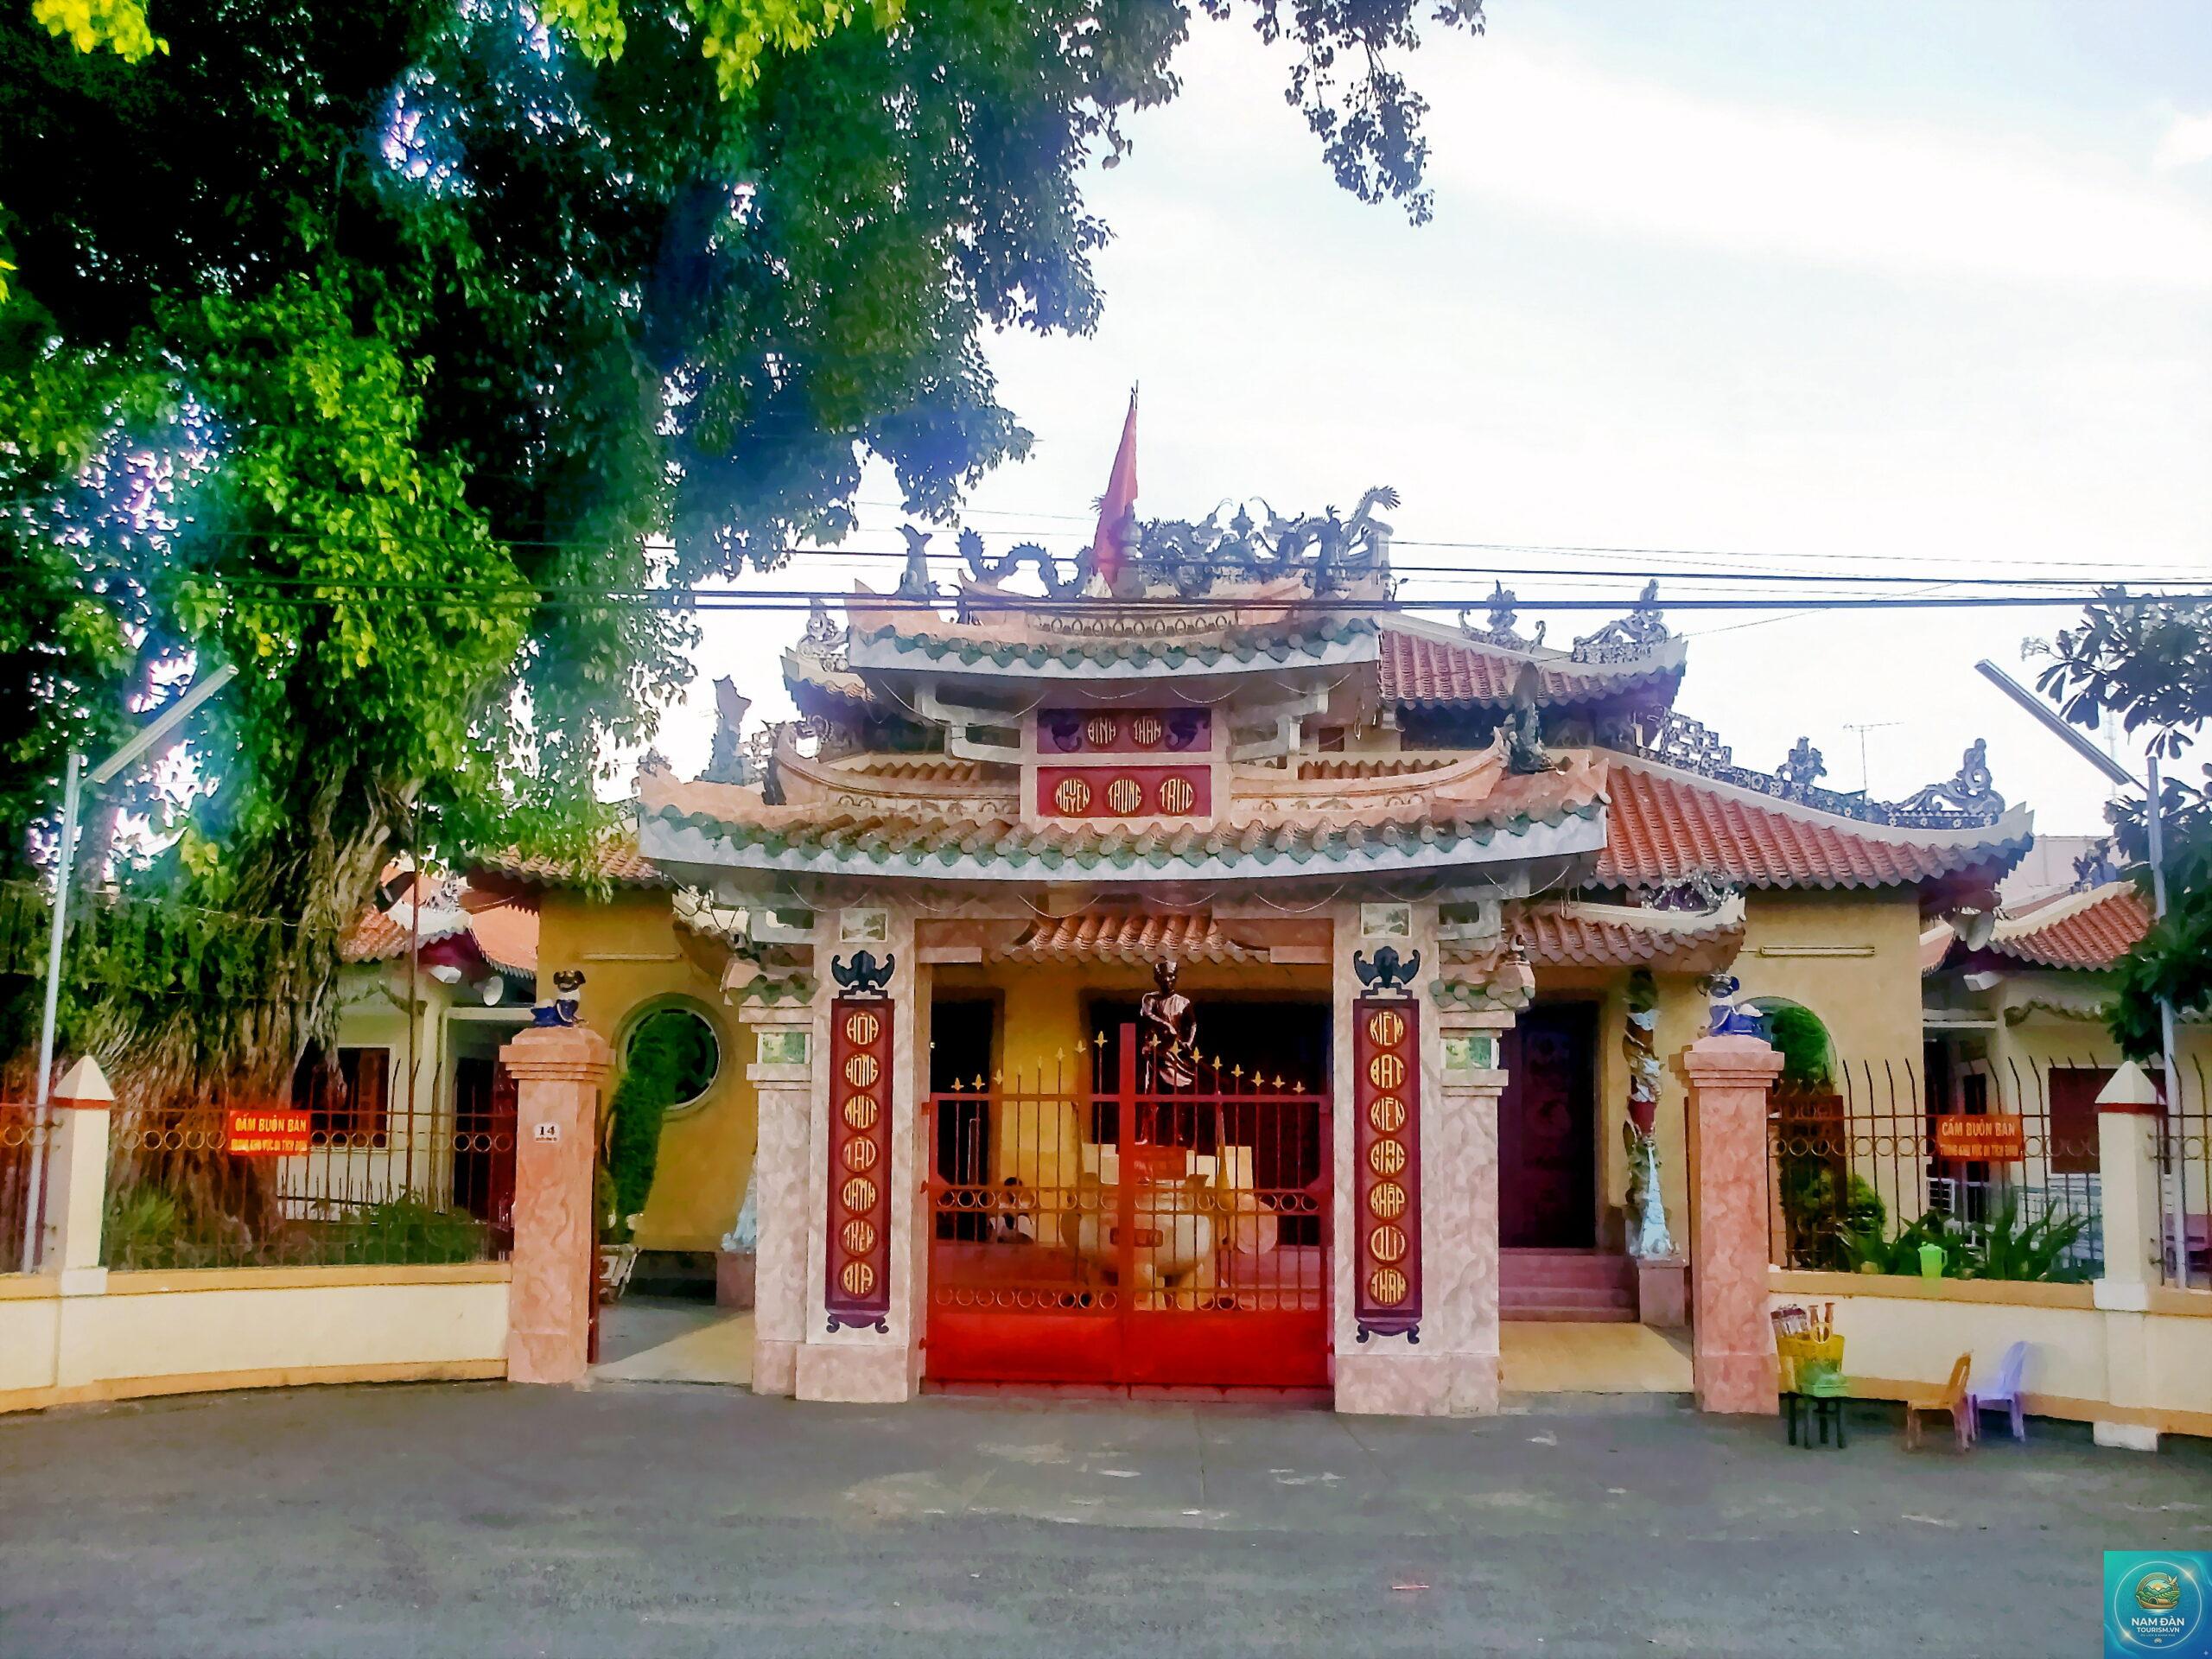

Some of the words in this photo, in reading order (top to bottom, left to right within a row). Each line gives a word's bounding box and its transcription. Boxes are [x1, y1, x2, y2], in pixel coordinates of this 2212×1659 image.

[1107, 779, 1142, 814] TRUNG
[539, 1126, 555, 1135] 14
[1370, 1140, 1406, 1174] GIANG
